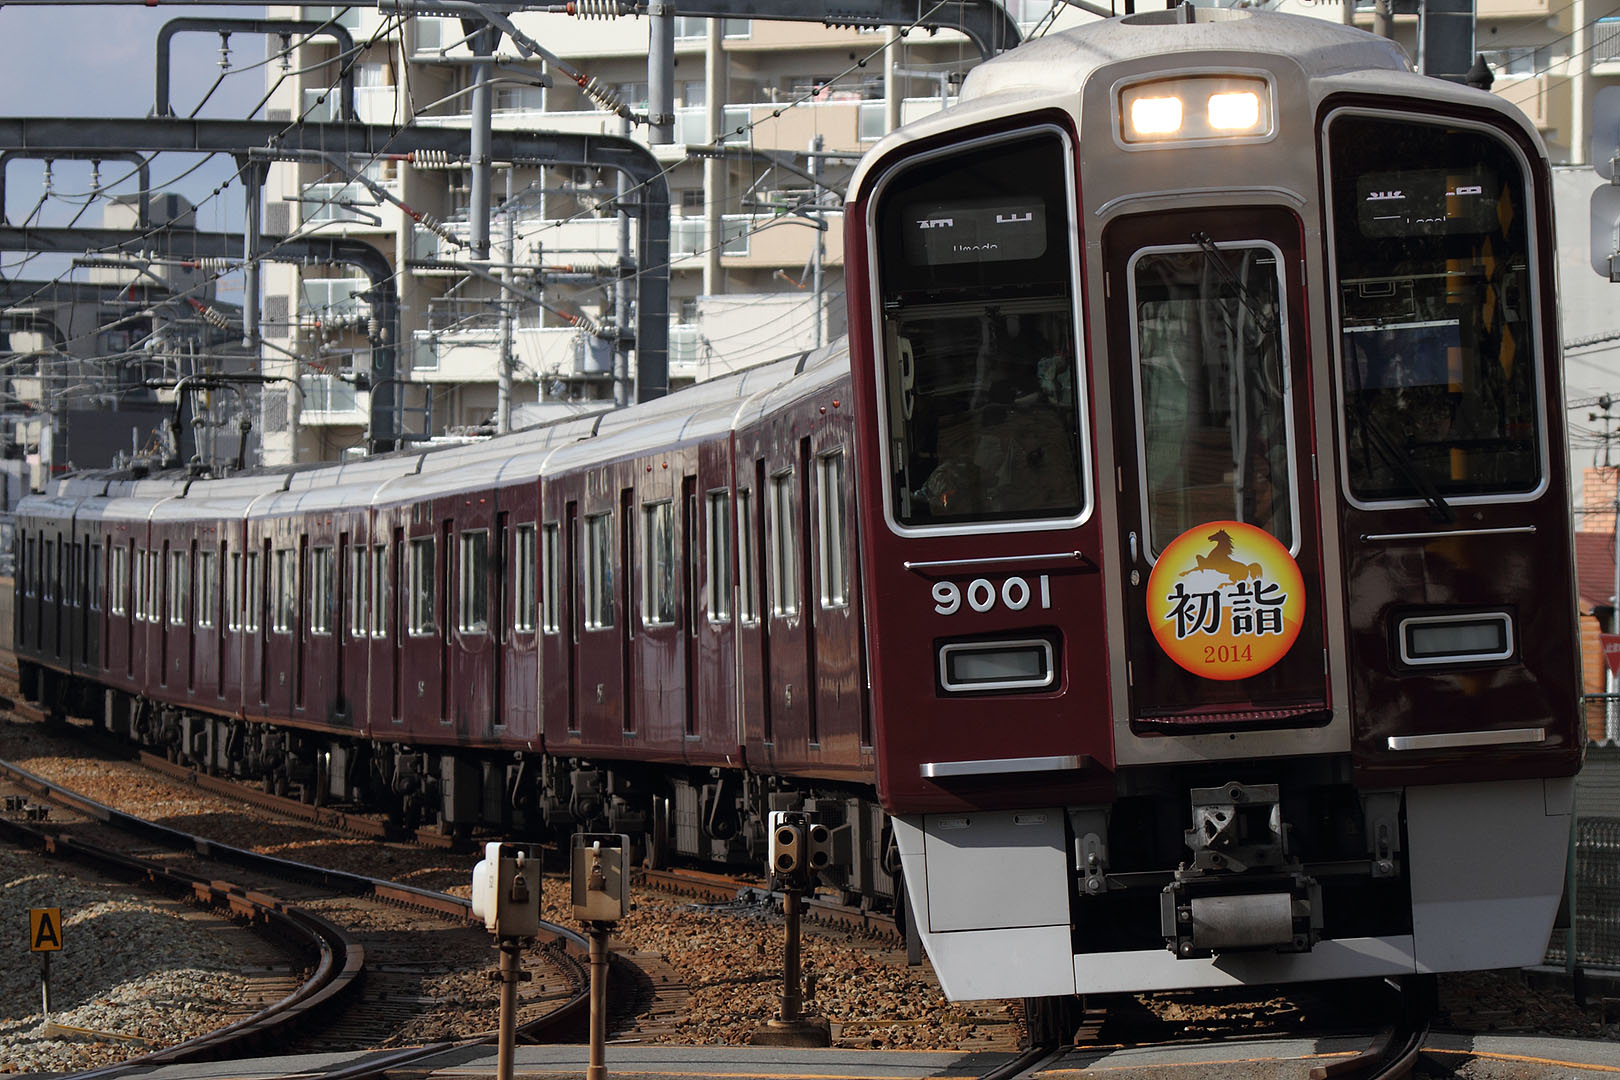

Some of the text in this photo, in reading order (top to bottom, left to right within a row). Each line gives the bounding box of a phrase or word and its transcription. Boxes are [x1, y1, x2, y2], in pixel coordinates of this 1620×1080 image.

[931, 574, 1051, 616] 9001
[1165, 580, 1287, 639] 初詣
[1204, 644, 1253, 664] 2014
[35, 912, 59, 948] A
